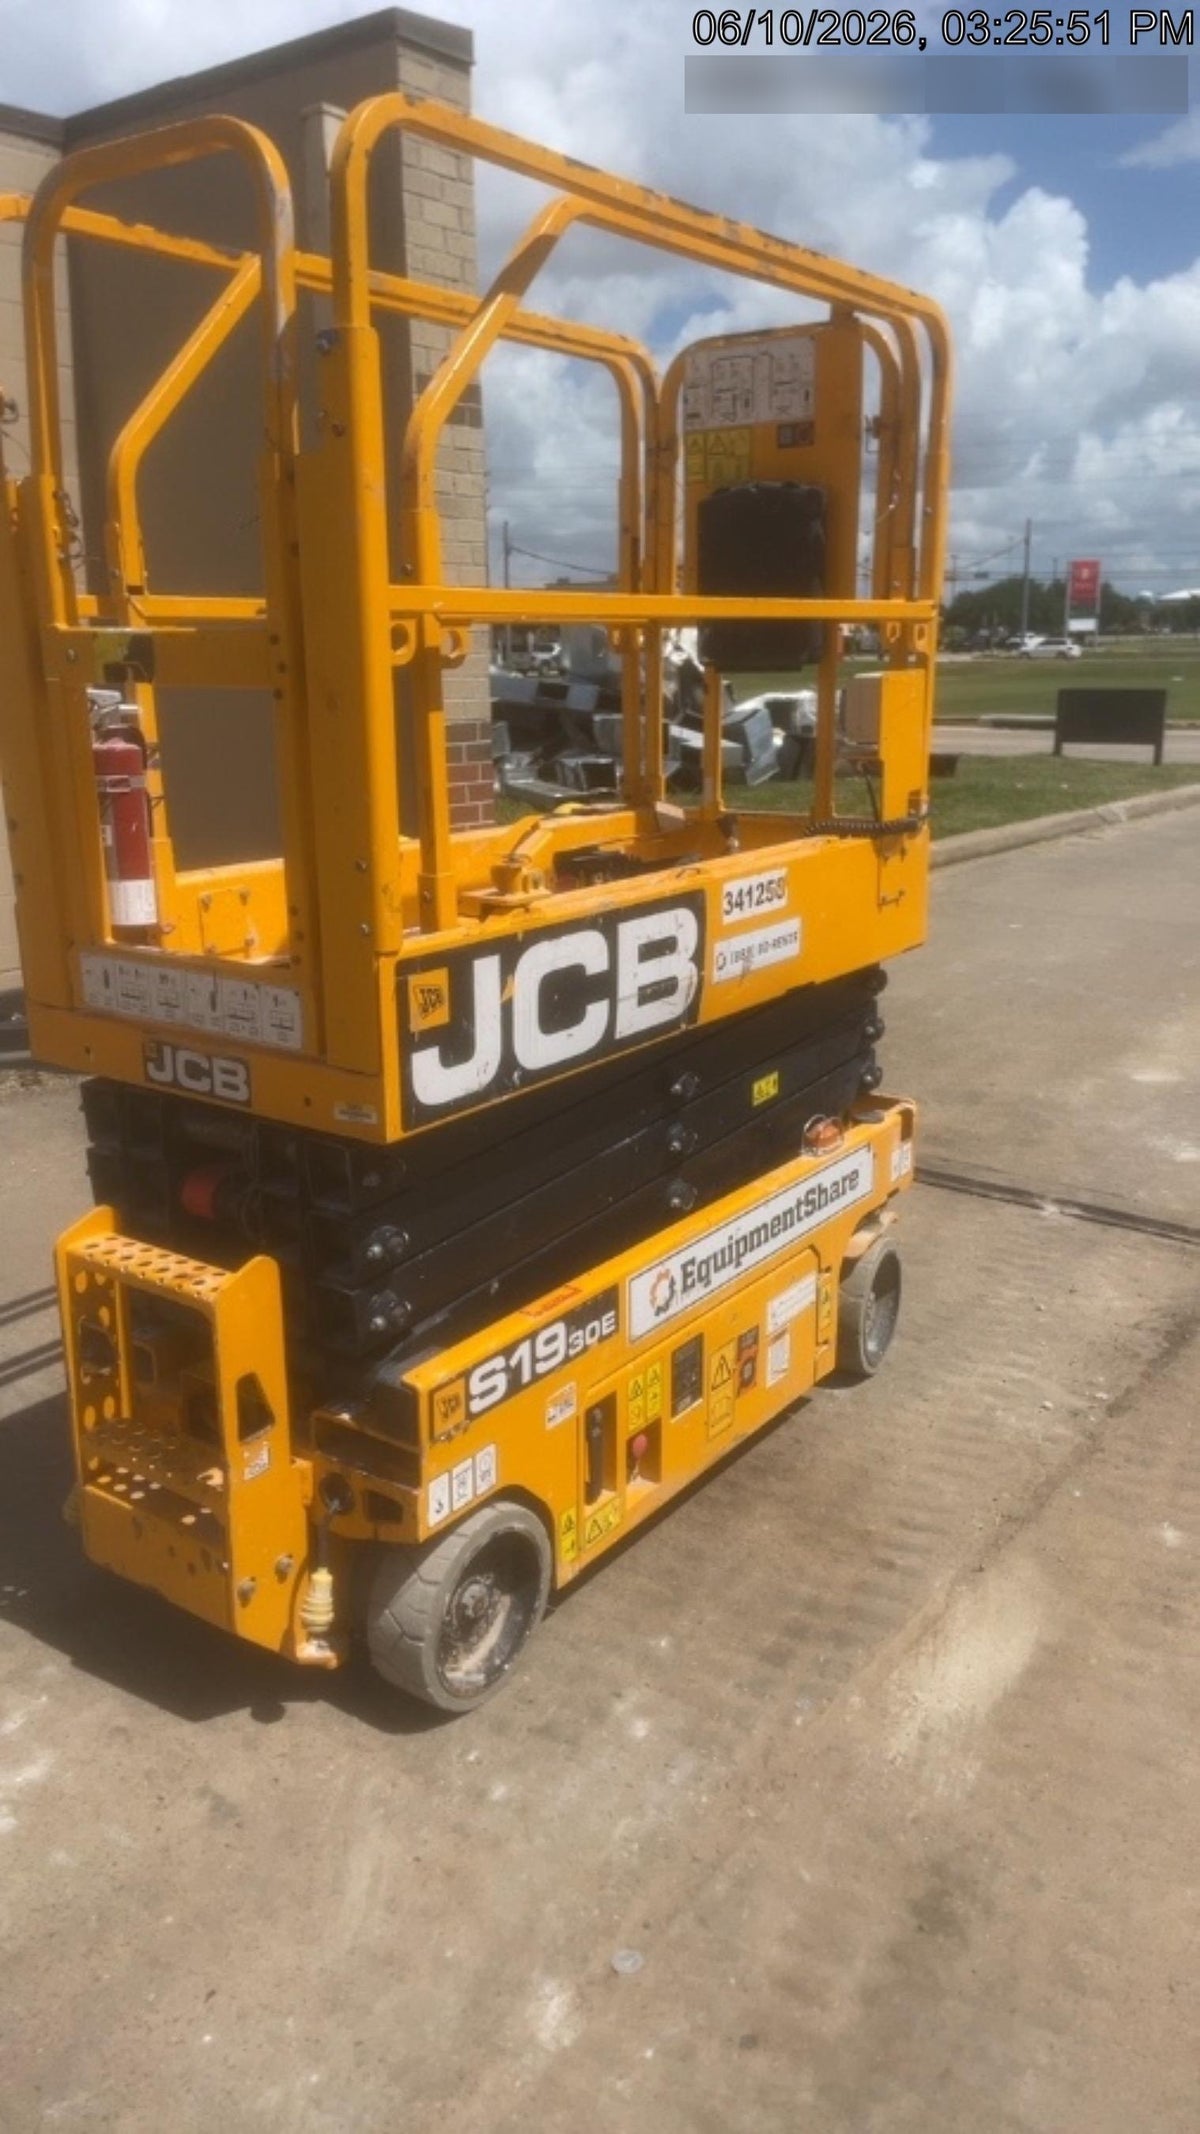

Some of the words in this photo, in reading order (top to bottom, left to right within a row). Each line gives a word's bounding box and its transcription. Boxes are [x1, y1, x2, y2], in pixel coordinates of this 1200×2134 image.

[411, 907, 699, 1106] JCB
[147, 1045, 250, 1101] JCB
[680, 1166, 860, 1293] EquipmentShare
